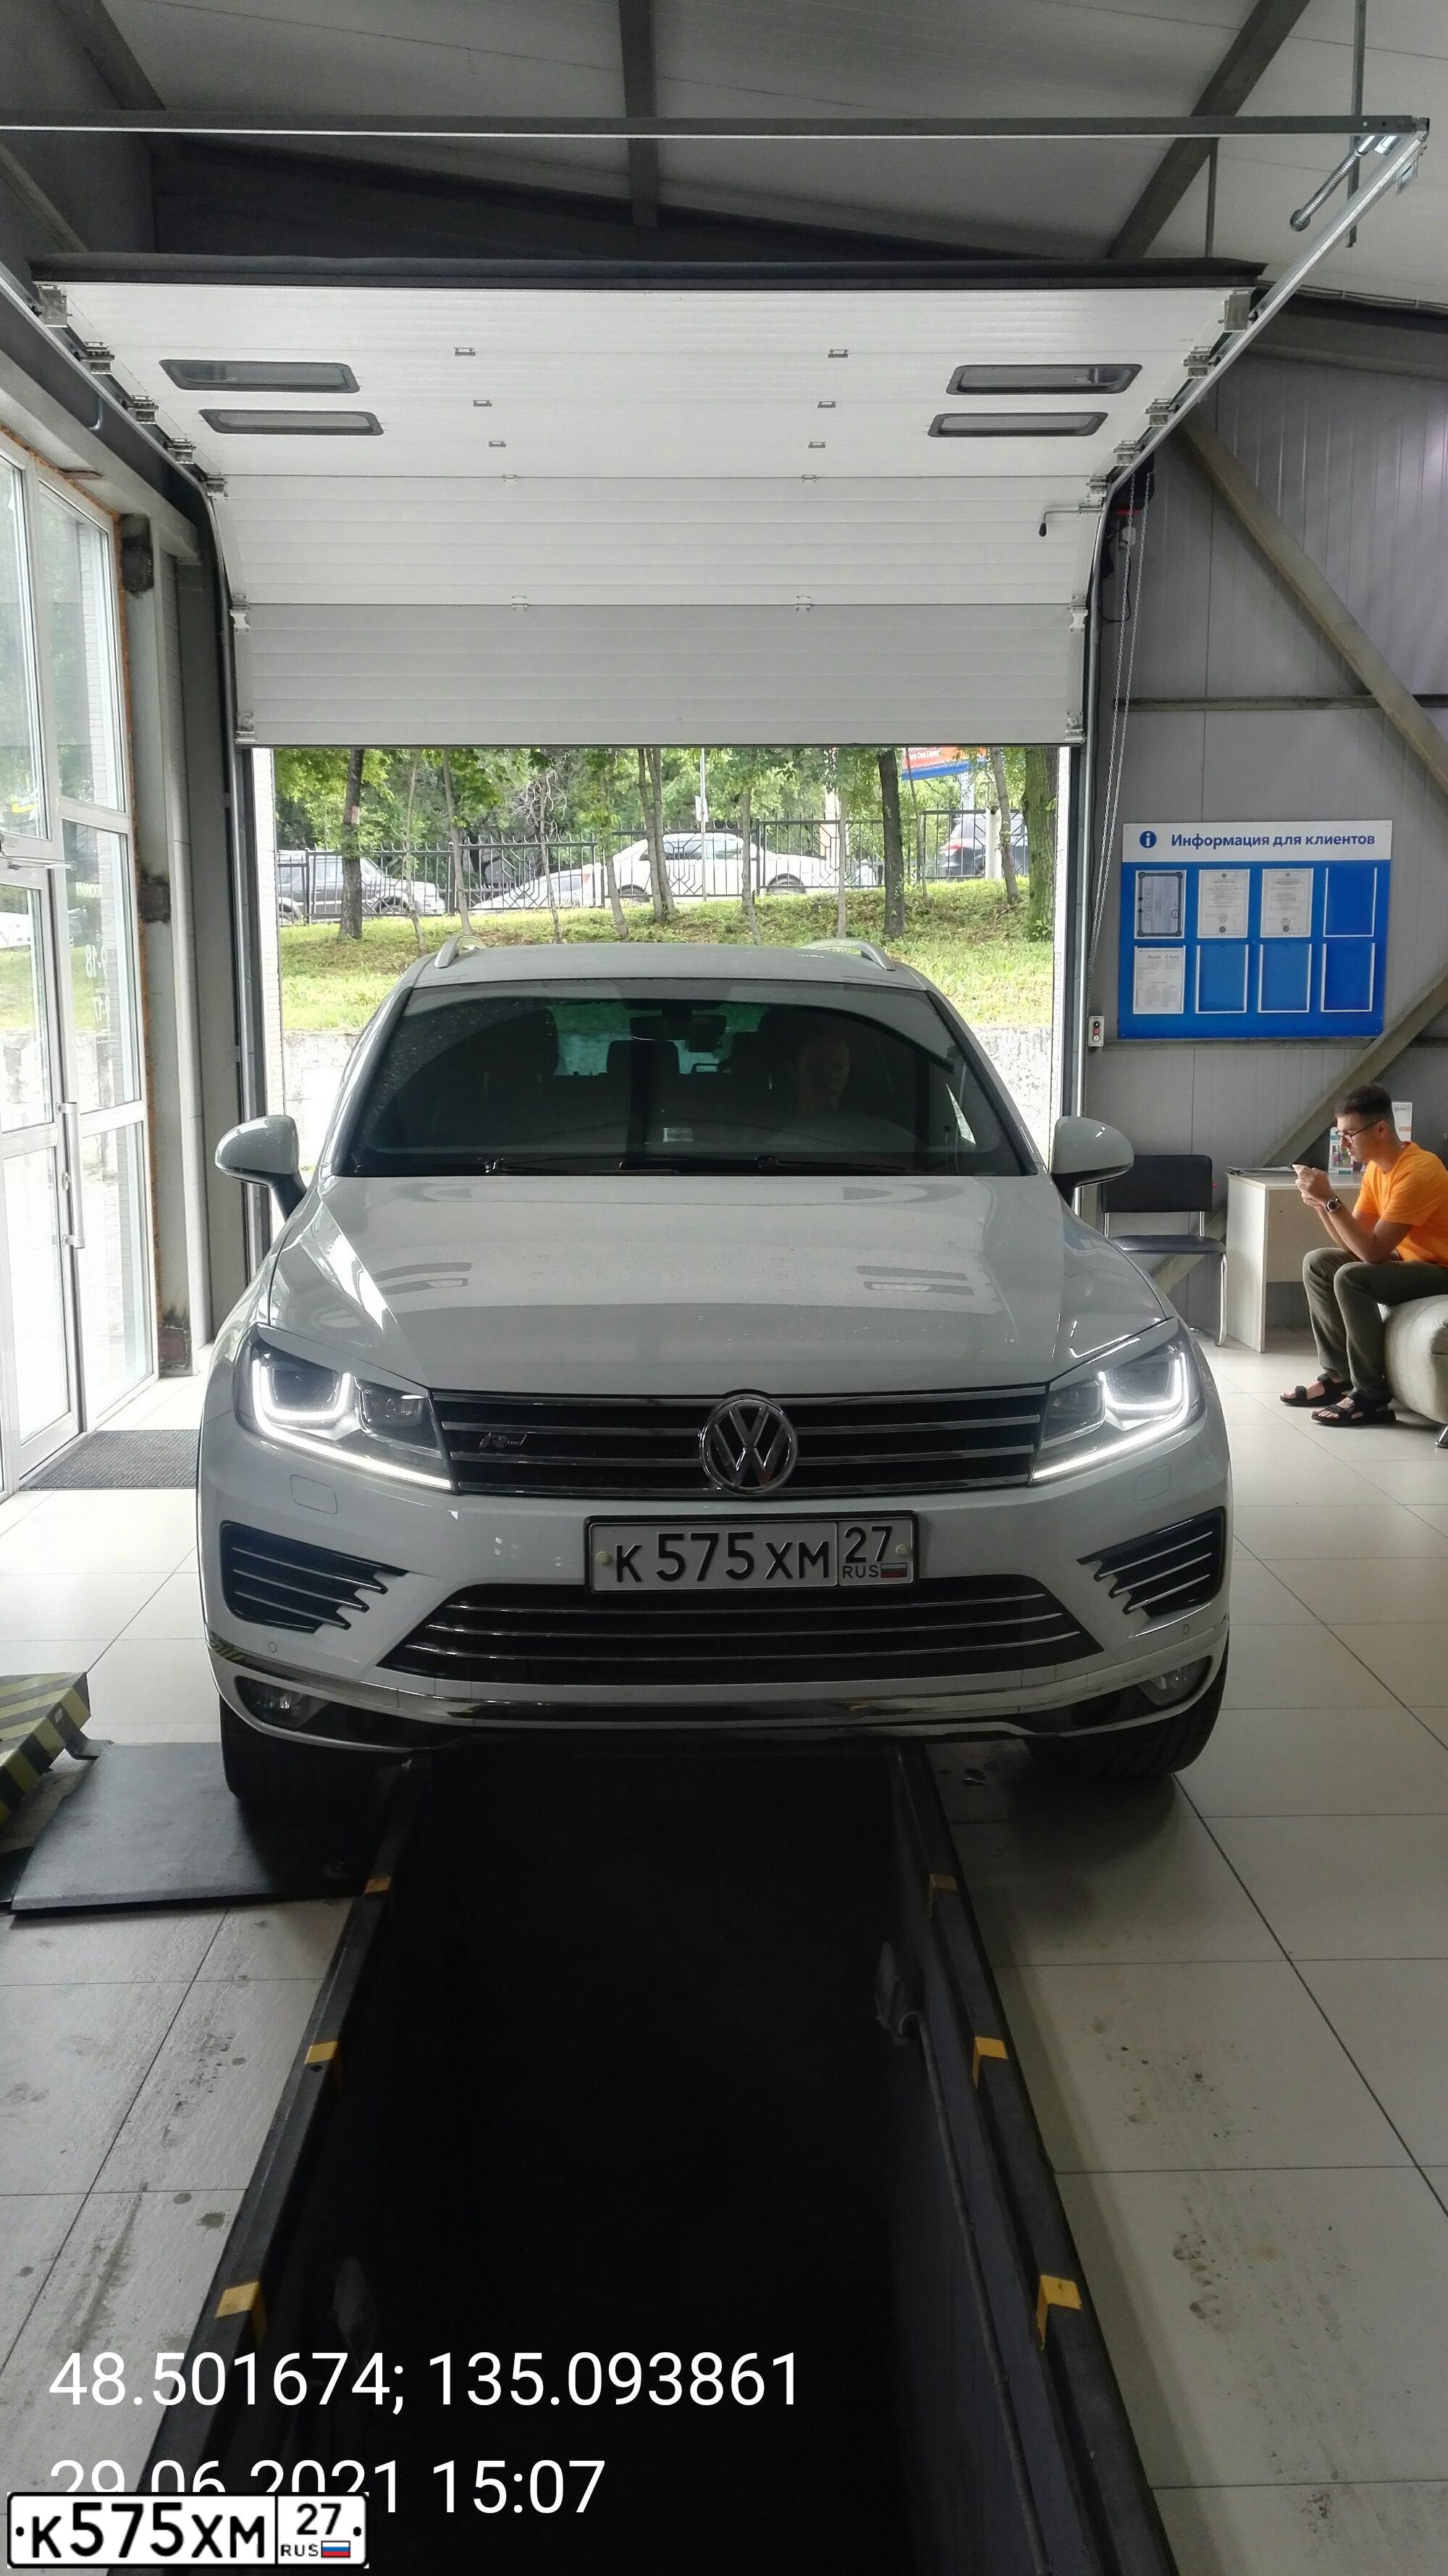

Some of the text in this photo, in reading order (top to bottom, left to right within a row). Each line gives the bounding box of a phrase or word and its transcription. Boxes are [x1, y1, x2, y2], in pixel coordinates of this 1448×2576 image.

[1171, 833, 1375, 849] Информация для клиентов
[843, 1525, 893, 1564] 27
[842, 1565, 879, 1578] RUS
